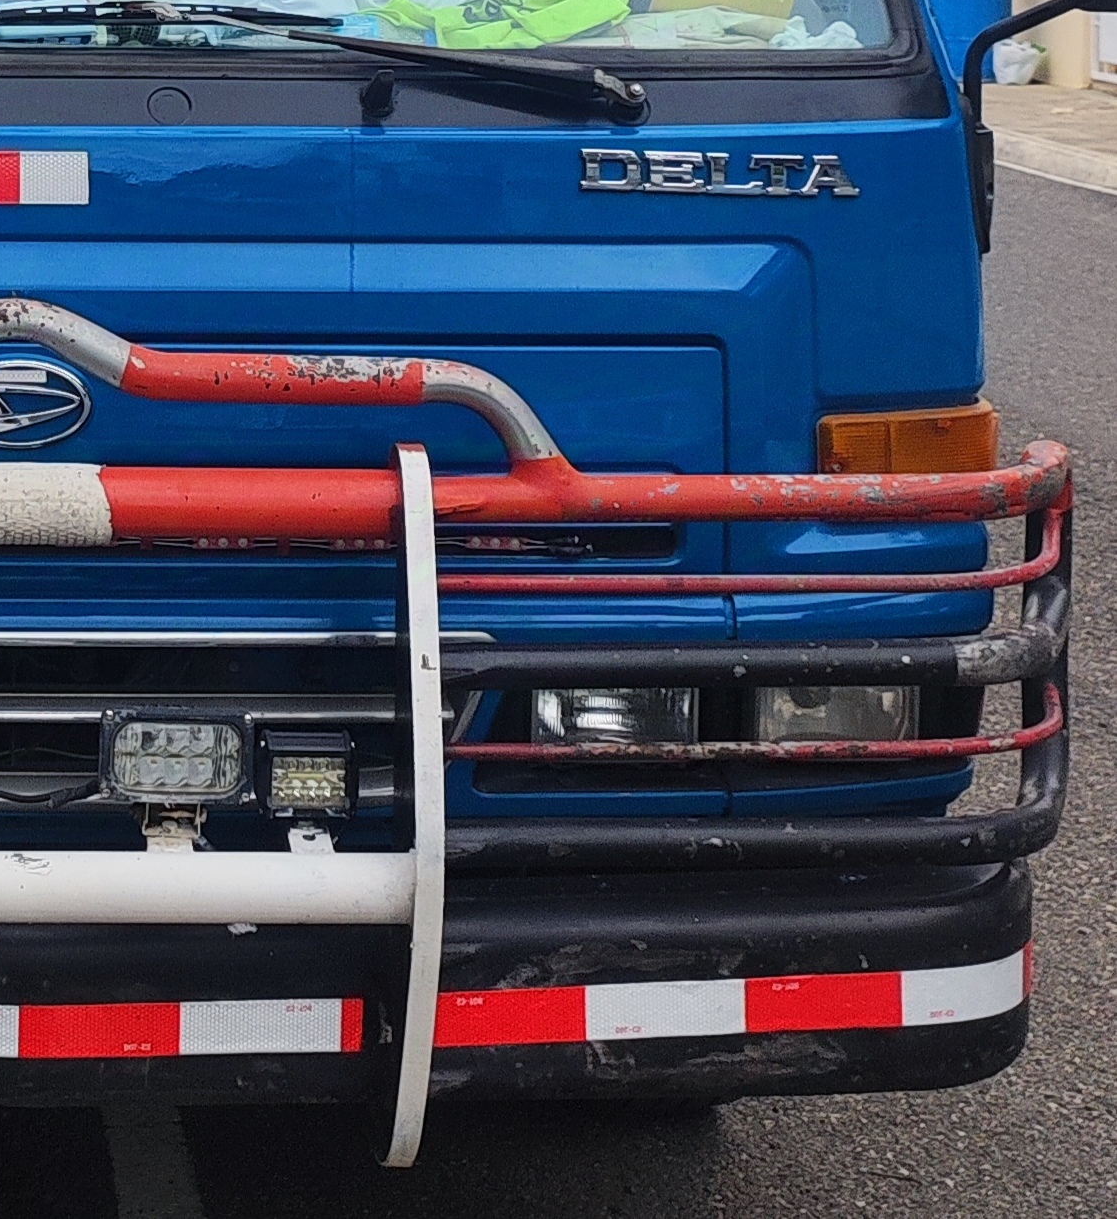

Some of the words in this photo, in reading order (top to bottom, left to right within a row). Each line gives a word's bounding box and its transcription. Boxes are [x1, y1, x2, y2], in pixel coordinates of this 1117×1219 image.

[581, 148, 860, 196] DELTA
[930, 1010, 955, 1018] DOT-C2
[615, 1025, 642, 1034] DOT-C2
